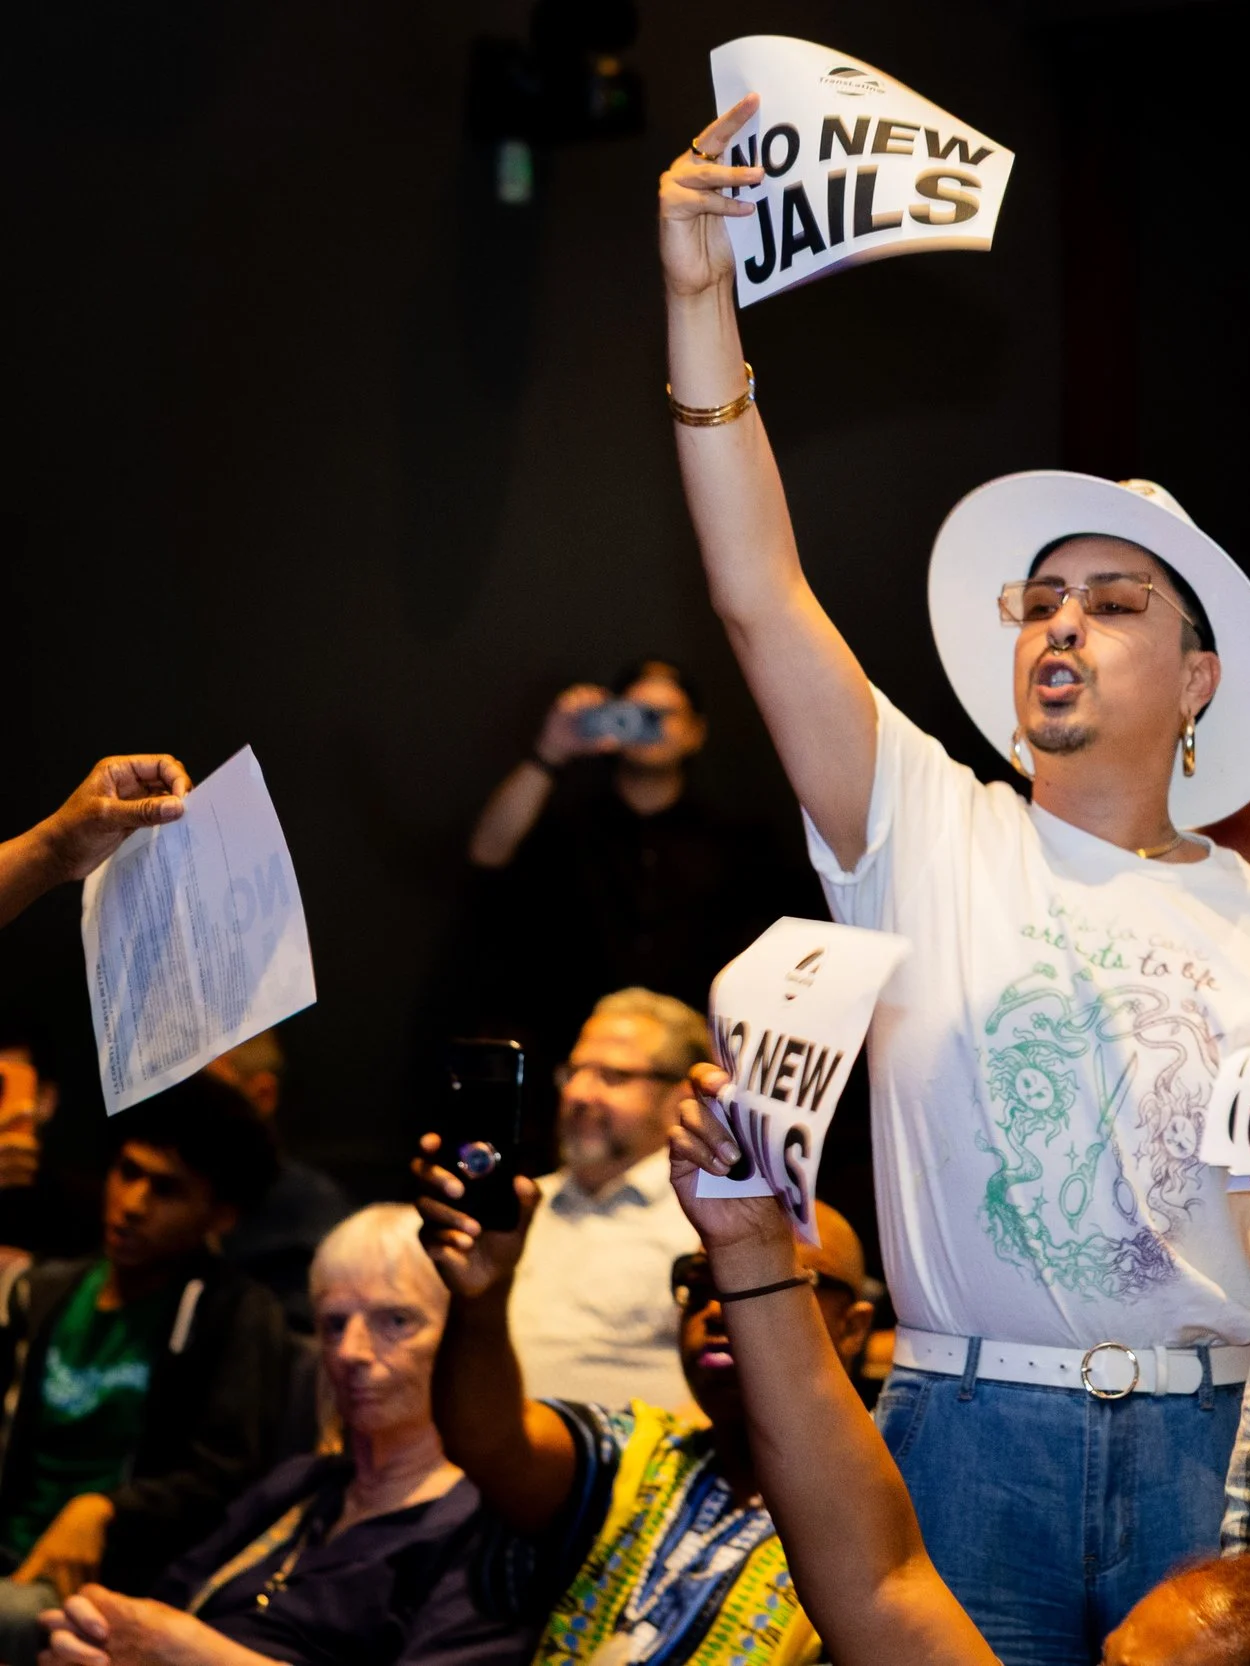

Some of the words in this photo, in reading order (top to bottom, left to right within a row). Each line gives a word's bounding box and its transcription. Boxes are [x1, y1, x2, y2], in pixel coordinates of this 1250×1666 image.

[731, 123, 800, 198] NO
[818, 115, 995, 167] NEW
[744, 165, 983, 285] JAILS
[746, 1028, 844, 1112] NEW
